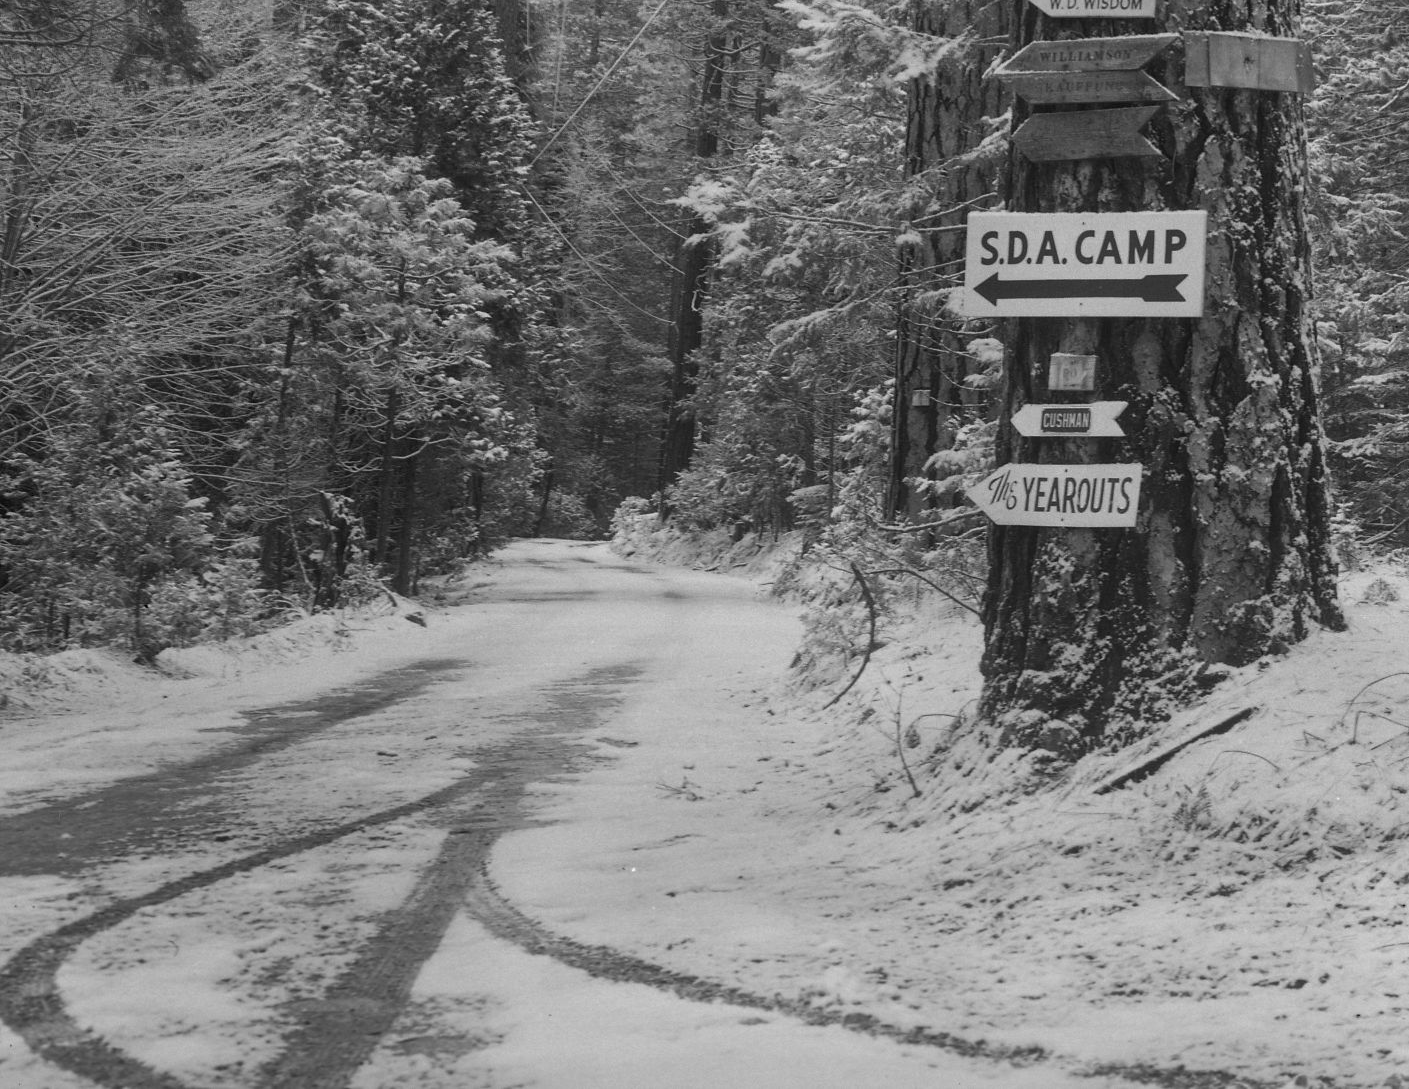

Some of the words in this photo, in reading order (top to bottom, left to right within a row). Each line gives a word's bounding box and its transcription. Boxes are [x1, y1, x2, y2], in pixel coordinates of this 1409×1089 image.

[1040, 49, 1133, 63] WILLIAMSON
[980, 230, 1067, 266] S.D.A.
[1075, 229, 1187, 265] CAMP
[1042, 413, 1090, 429] CUSHMAN
[988, 470, 1018, 511] The
[1022, 476, 1133, 514] YEAROUTS
